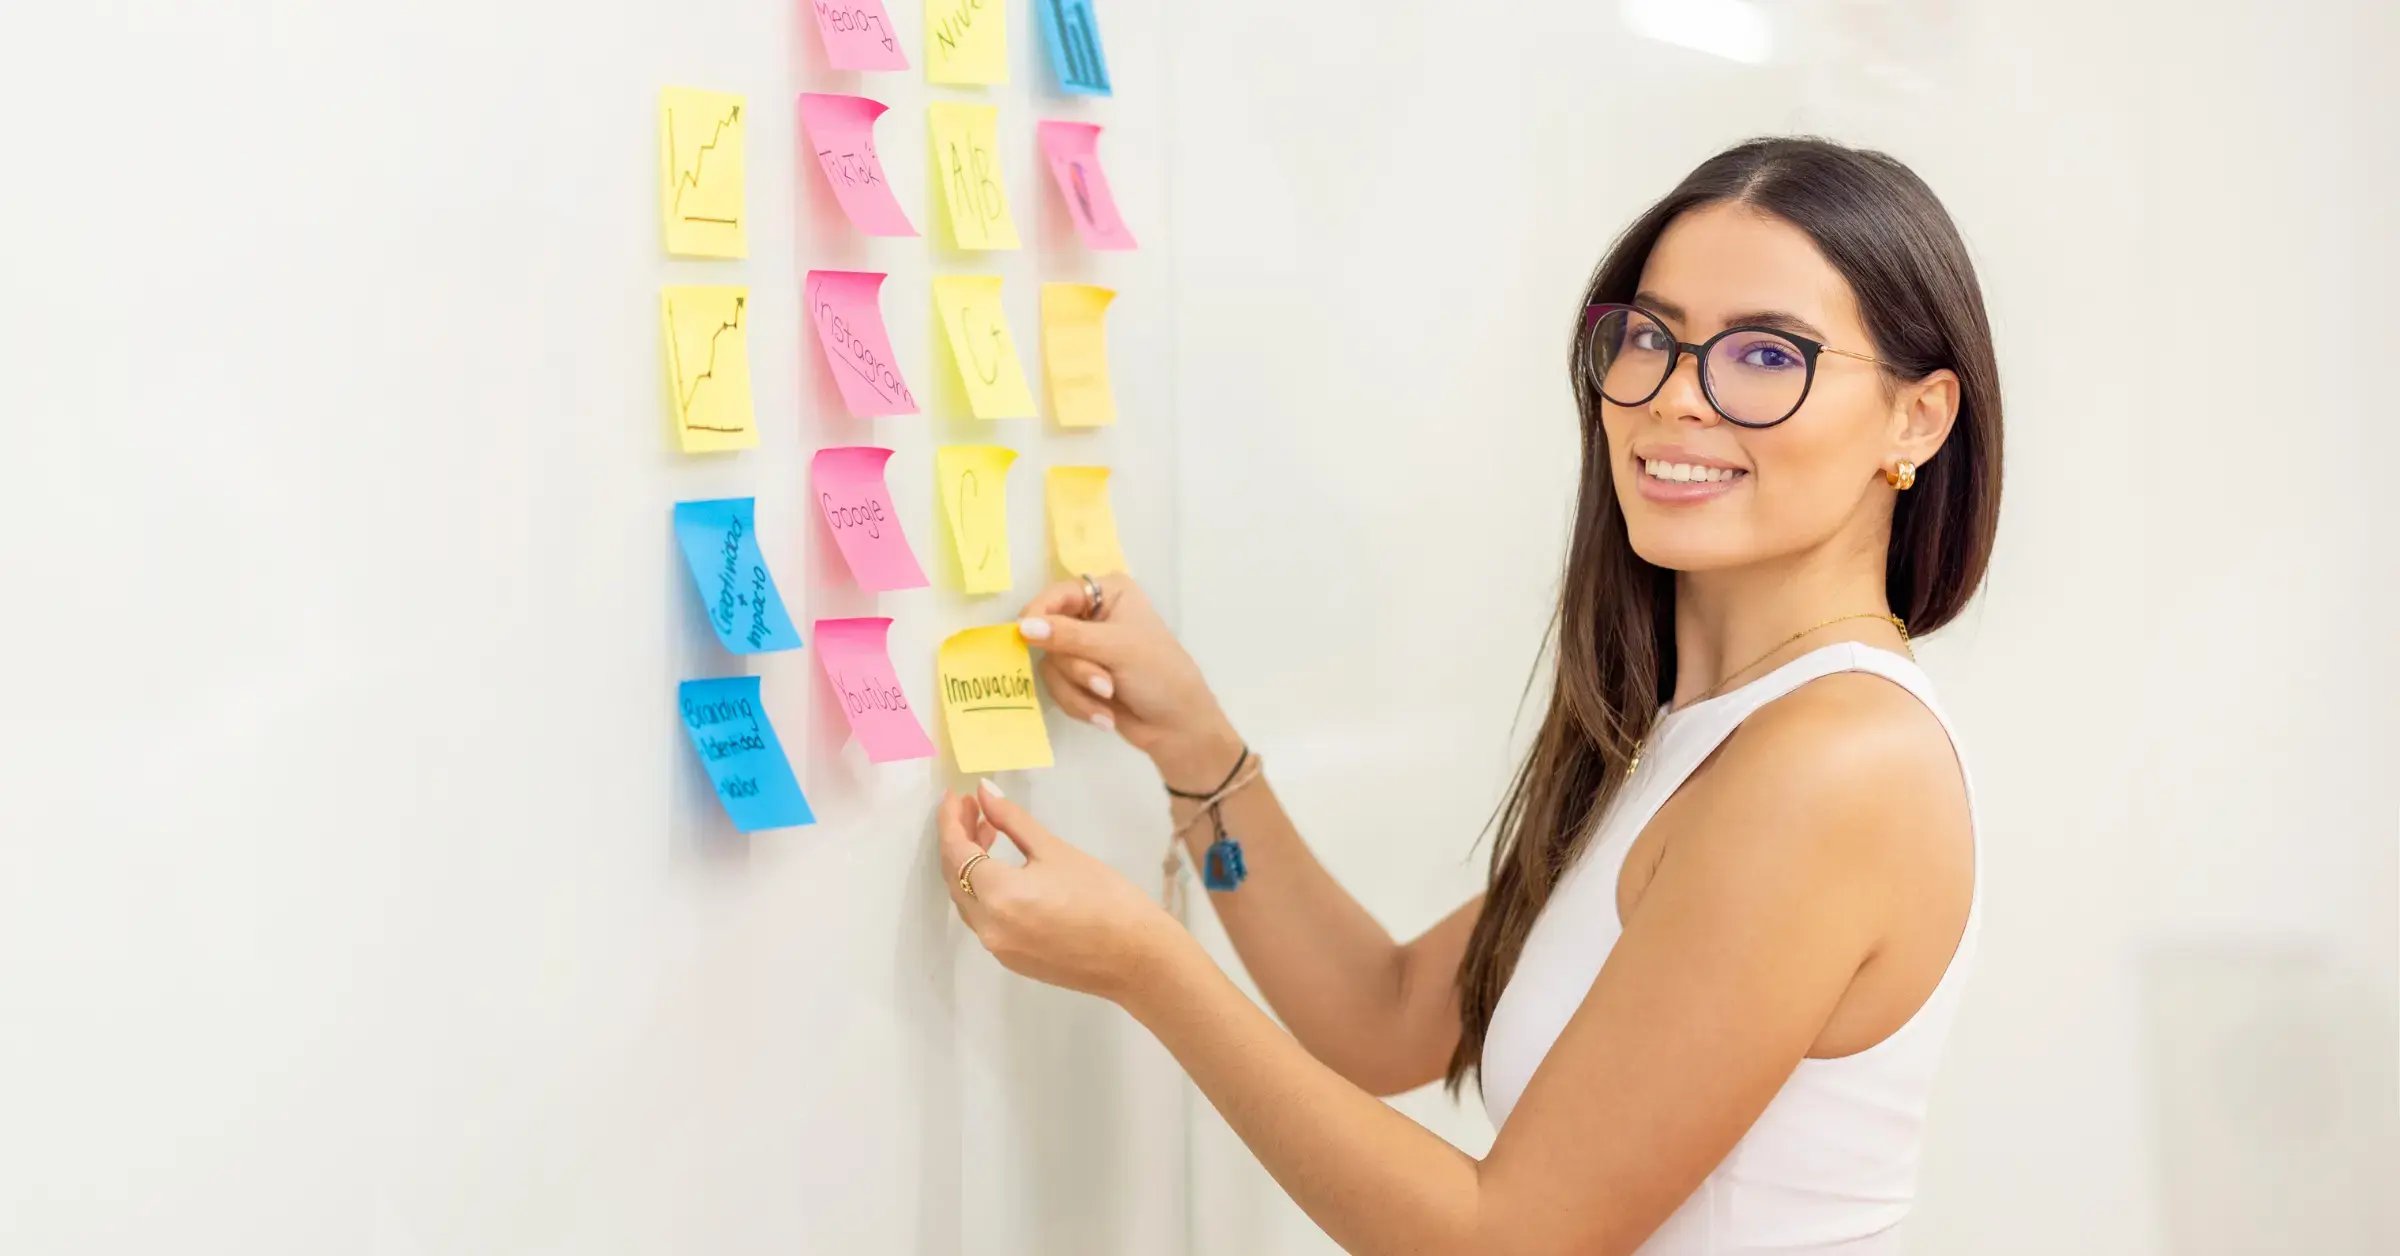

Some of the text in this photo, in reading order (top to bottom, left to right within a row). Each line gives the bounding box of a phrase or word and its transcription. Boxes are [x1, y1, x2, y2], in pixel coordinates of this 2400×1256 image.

[814, 0, 872, 34] Media
[822, 491, 886, 539] Google
[830, 671, 908, 718] Youtube
[944, 667, 1033, 704] Innovación
[681, 696, 759, 732] Branding
